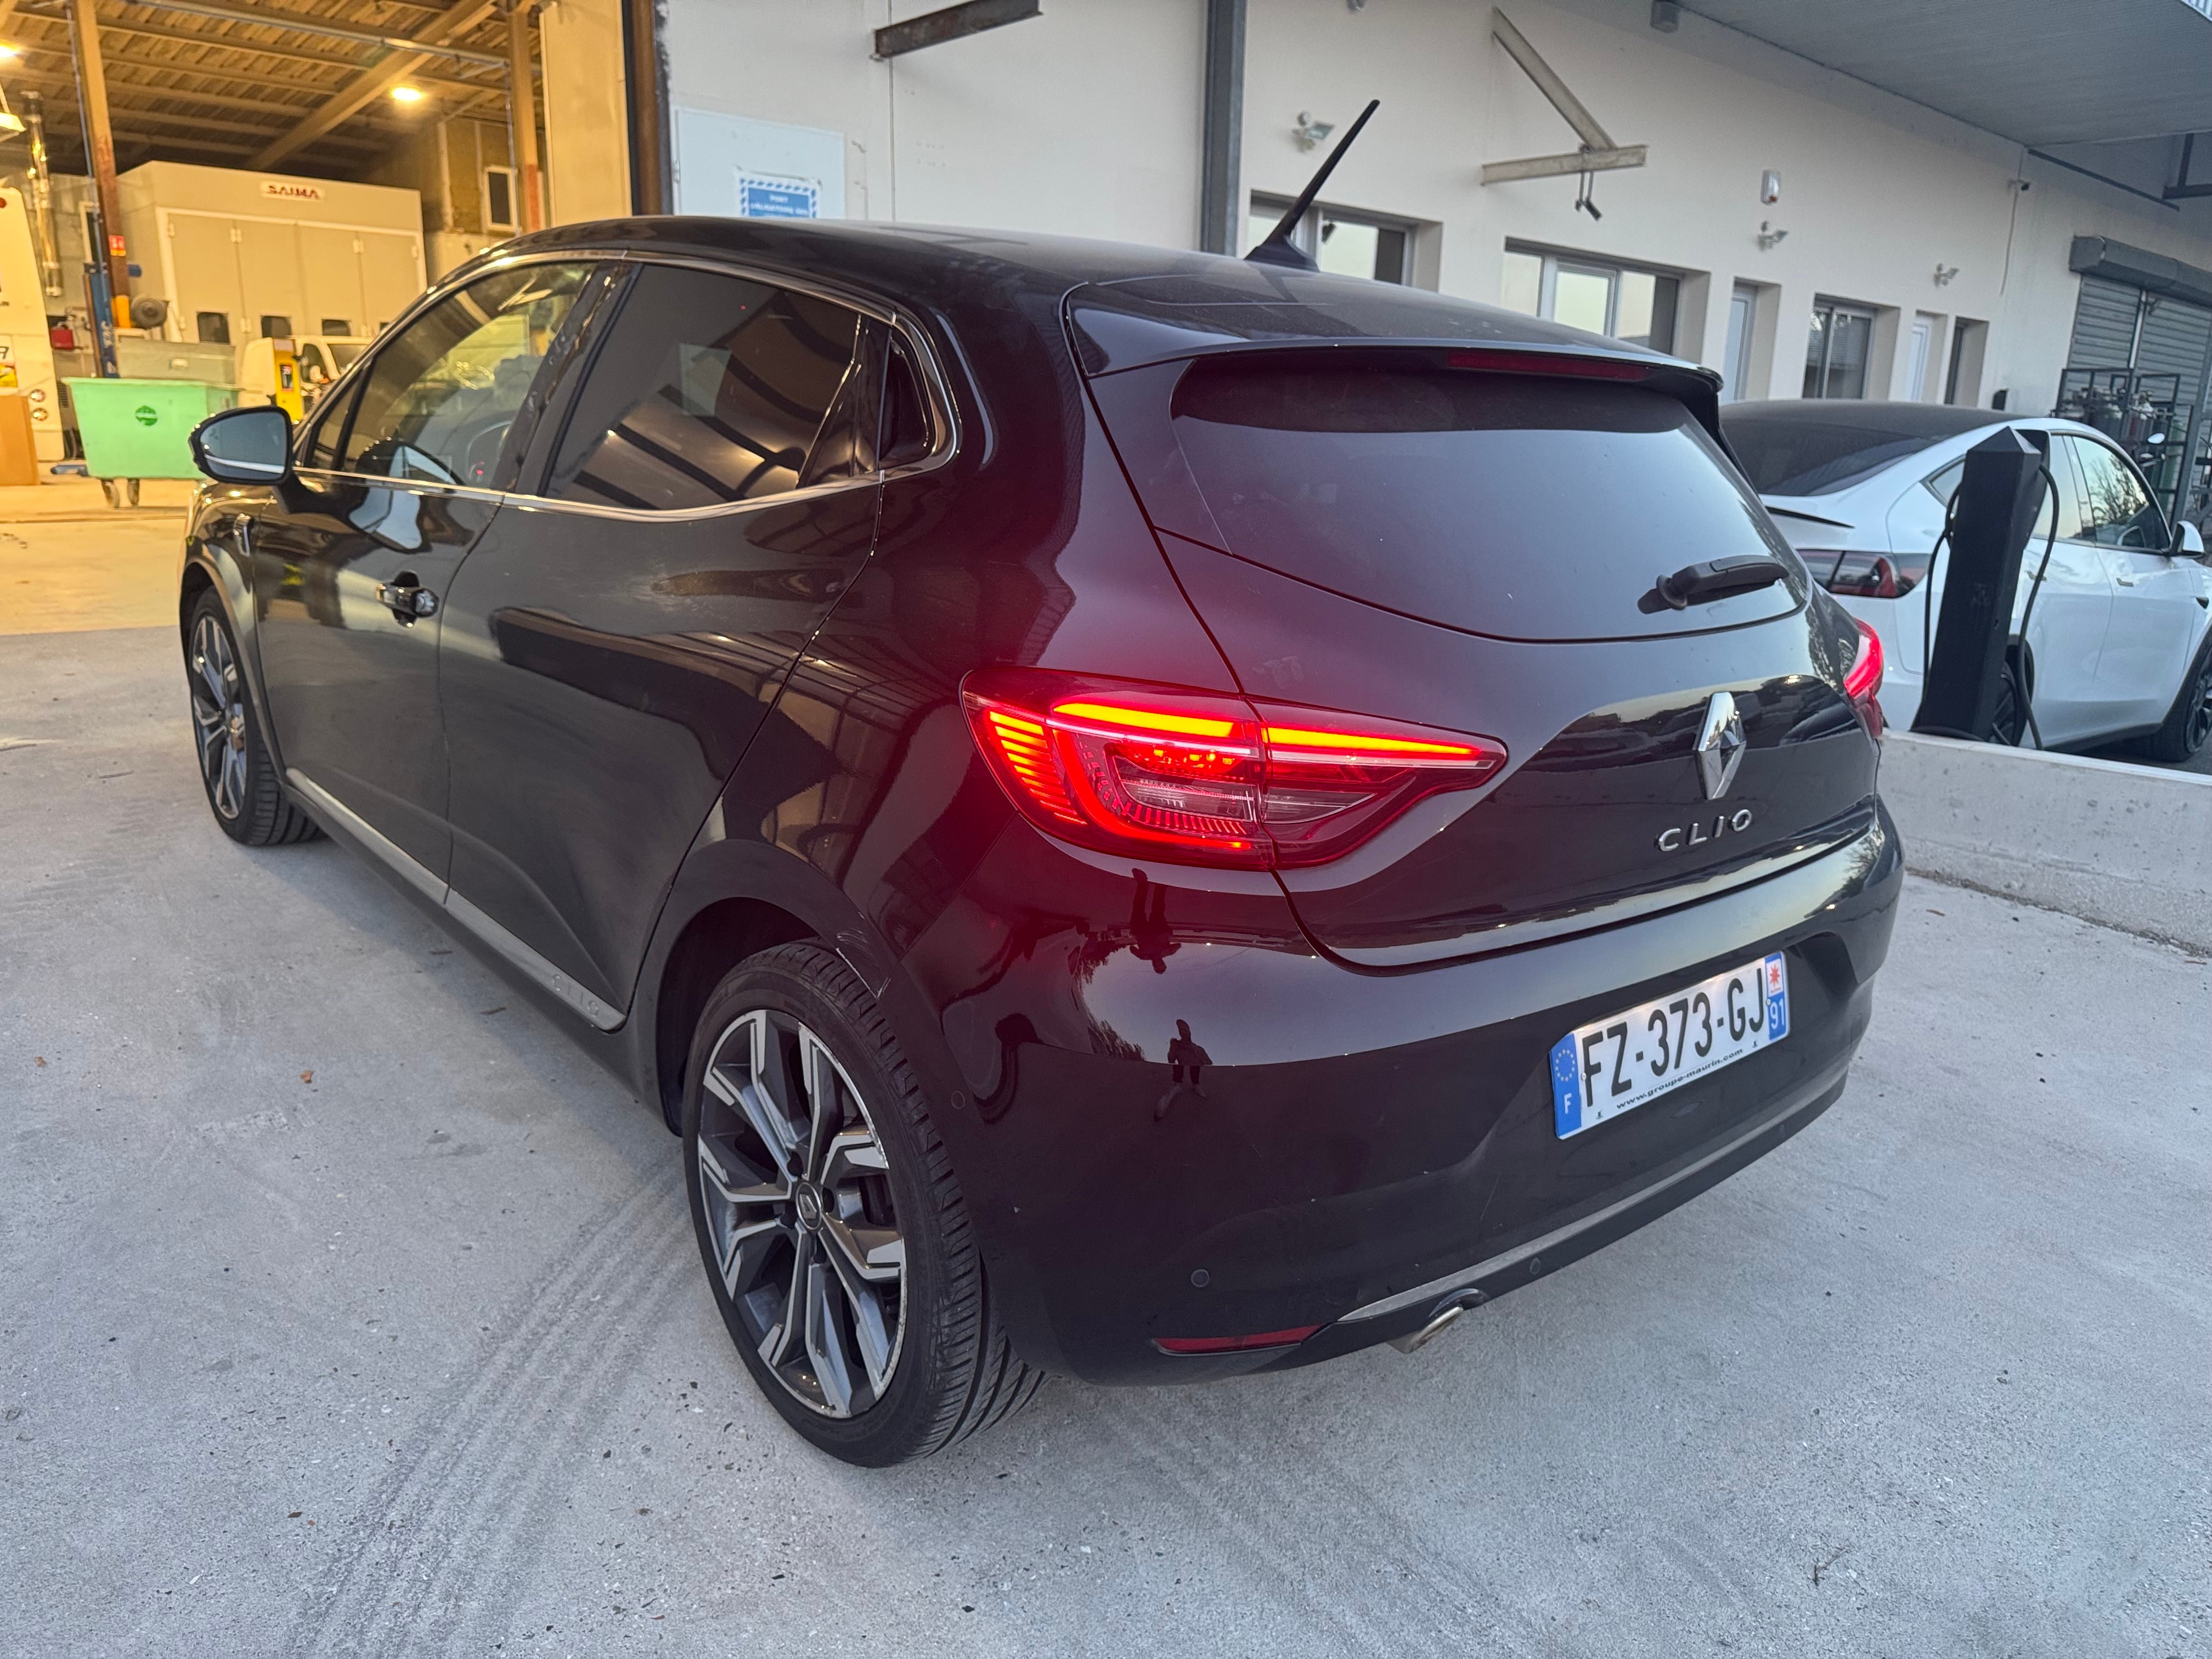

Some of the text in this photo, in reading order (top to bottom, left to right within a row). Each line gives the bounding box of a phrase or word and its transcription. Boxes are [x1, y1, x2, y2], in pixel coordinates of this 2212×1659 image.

[267, 185, 320, 200] SAIMA
[1658, 809, 1752, 852] CLIO
[1769, 997, 1785, 1030] 91
[1582, 968, 1764, 1108] FZ-373-GJ
[1616, 1048, 1743, 1109] www.groupe-maurin.com
[1564, 1093, 1572, 1114] F
